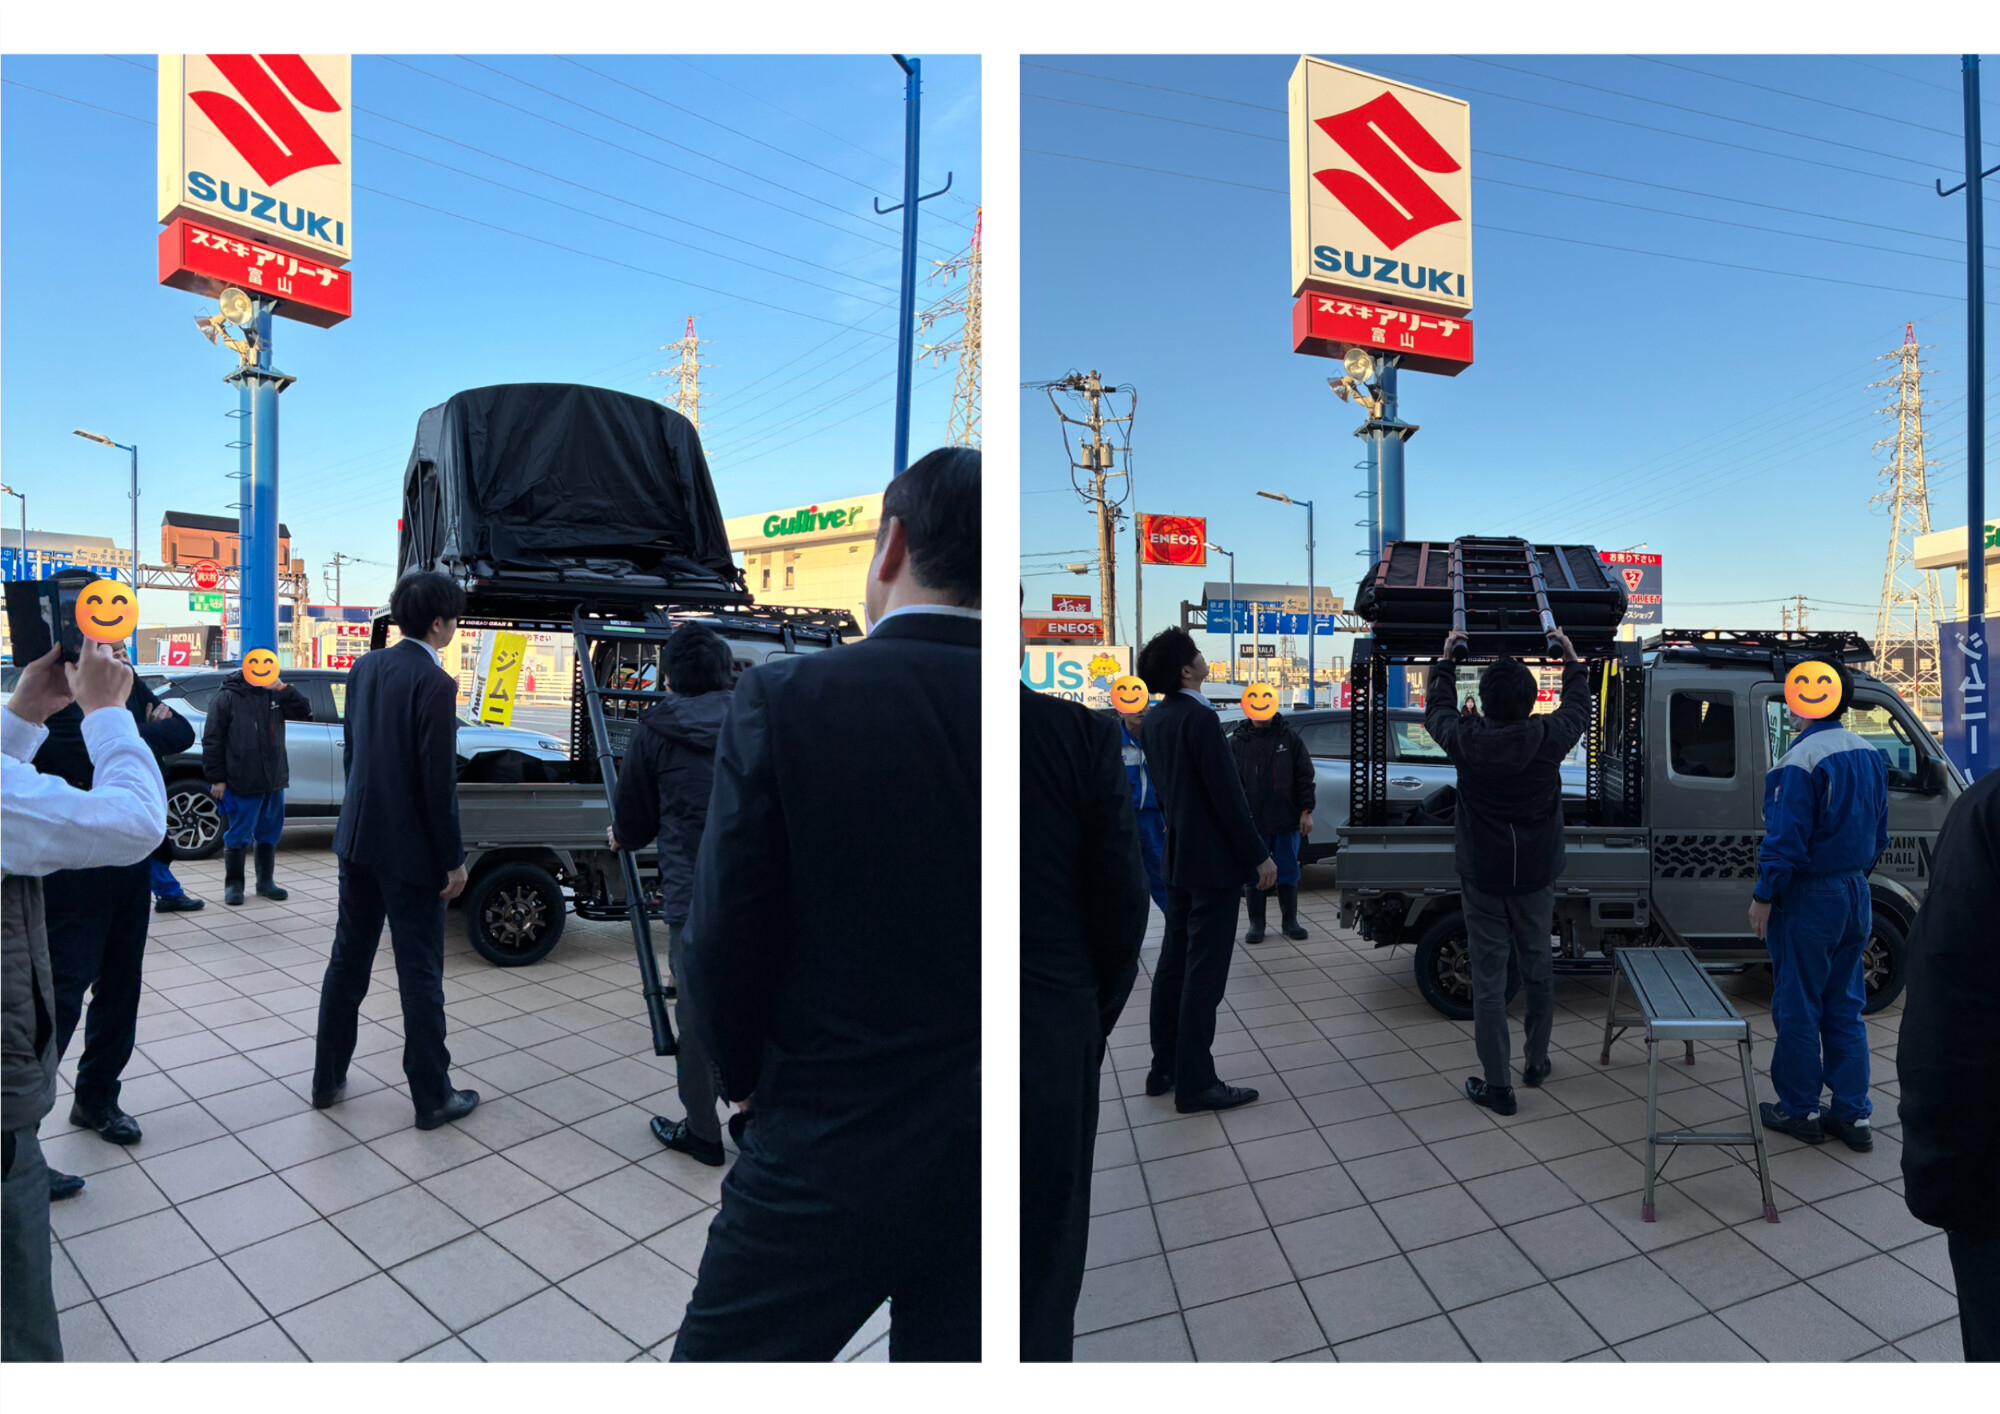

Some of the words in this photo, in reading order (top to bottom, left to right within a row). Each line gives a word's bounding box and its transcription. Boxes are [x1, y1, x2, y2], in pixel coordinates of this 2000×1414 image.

[188, 170, 344, 247] SUZUKI
[191, 228, 339, 287] スズキアリーナ
[248, 266, 293, 295] 富山
[1313, 244, 1465, 298] SUZUKI
[1317, 298, 1460, 338] スズキアリーナ
[1371, 325, 1415, 349] 富山
[763, 505, 863, 538] Gulliver
[1150, 533, 1199, 546] ENEOS
[1609, 553, 1656, 564] お売り下さい
[197, 571, 217, 582] 消火栓
[1048, 623, 1095, 633] ENEOS
[330, 656, 338, 667] P
[1242, 646, 1274, 654] LIBRALA
